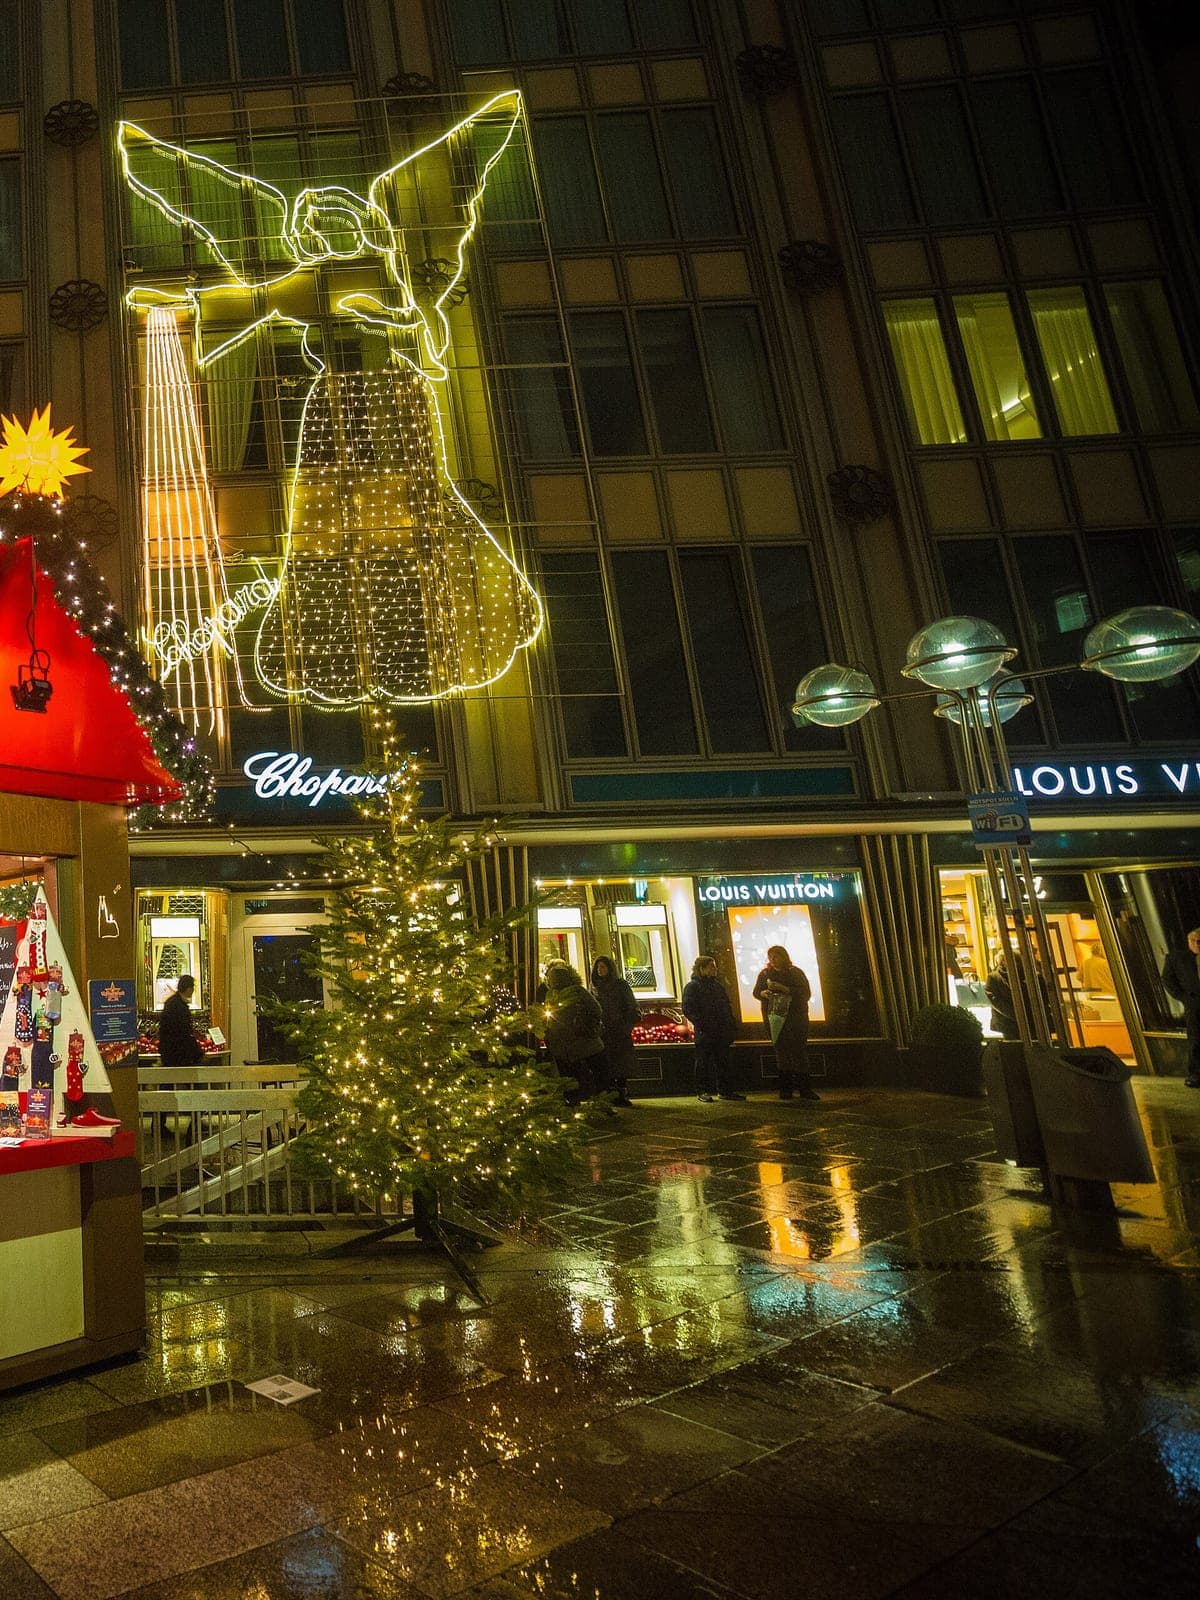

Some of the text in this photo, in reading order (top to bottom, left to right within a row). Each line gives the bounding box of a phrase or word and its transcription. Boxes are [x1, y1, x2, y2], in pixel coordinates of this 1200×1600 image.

[141, 556, 279, 683] Chopard
[1014, 763, 1200, 796] LOUIS V
[698, 883, 834, 902] LOUIS VUITTON
